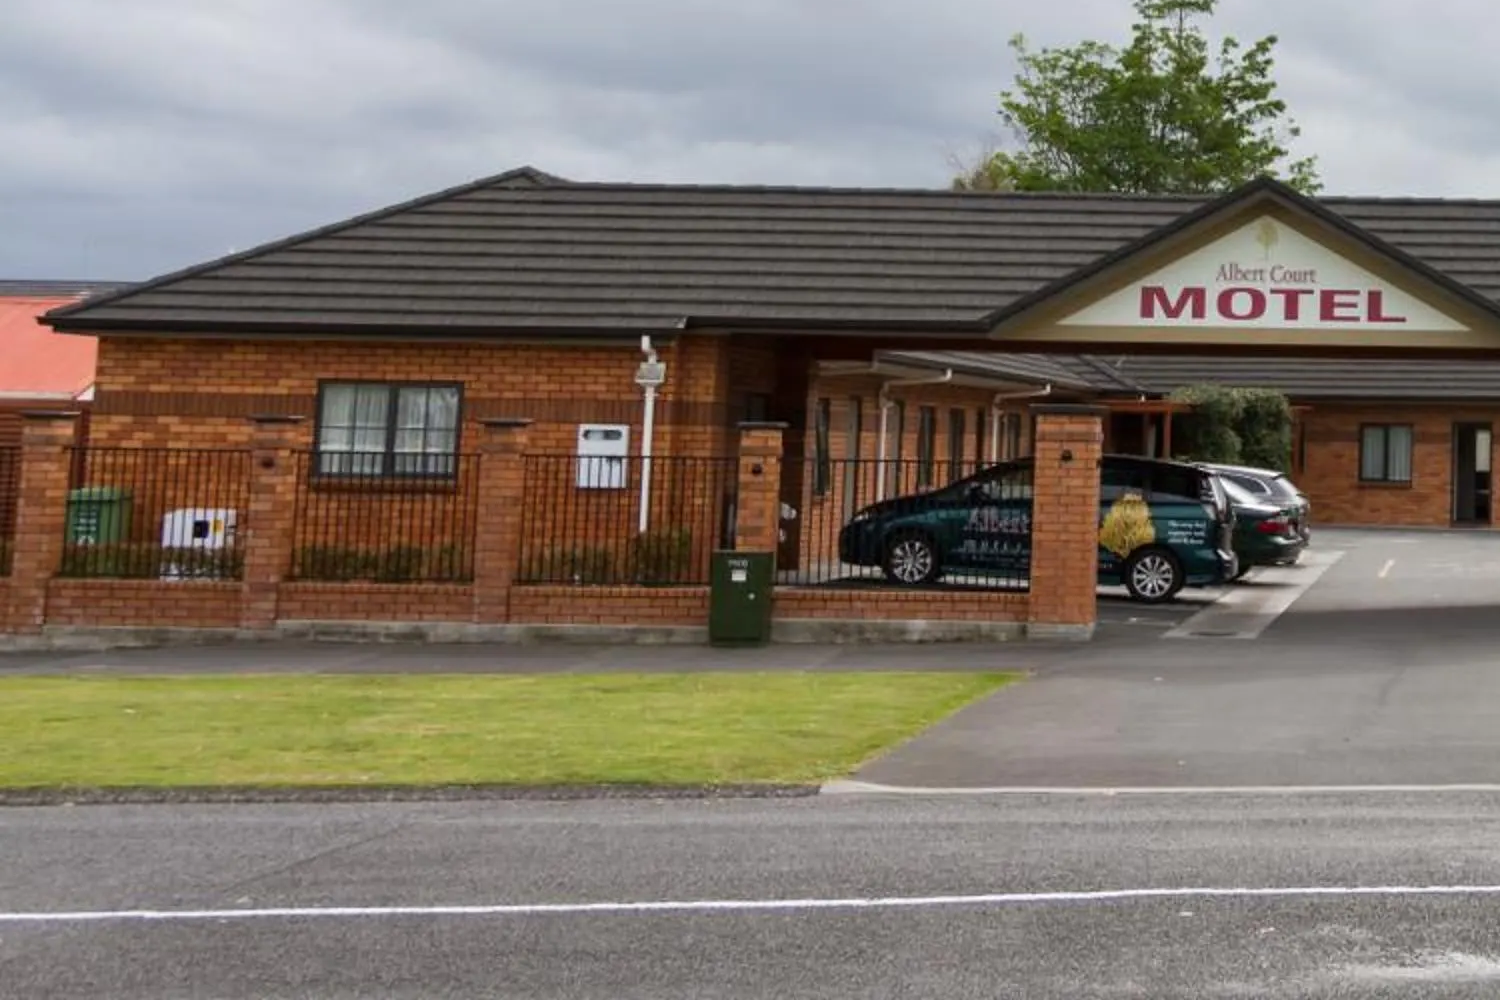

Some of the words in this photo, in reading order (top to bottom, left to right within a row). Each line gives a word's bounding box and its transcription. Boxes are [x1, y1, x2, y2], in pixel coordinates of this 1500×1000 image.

[1216, 263, 1264, 282] Albert
[1269, 264, 1317, 283] Court
[1140, 286, 1406, 323] MOTEL
